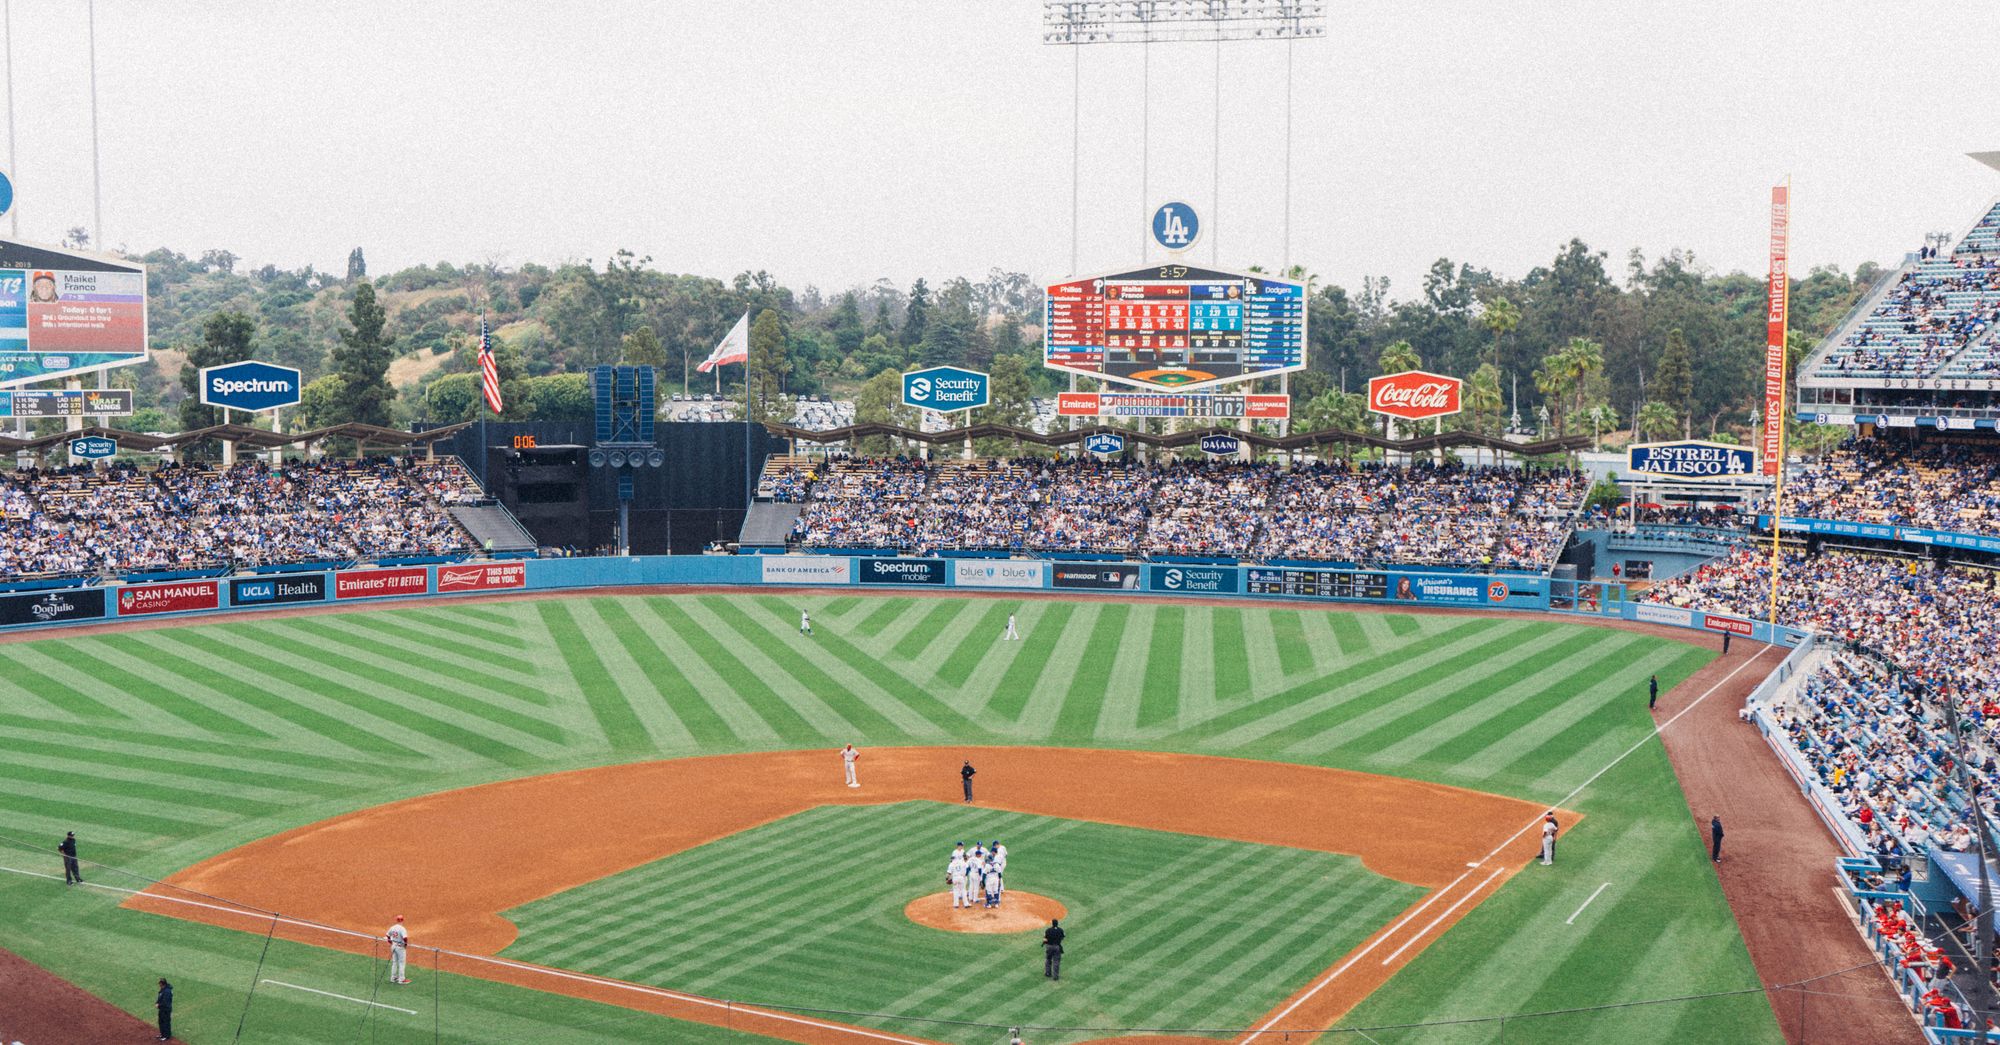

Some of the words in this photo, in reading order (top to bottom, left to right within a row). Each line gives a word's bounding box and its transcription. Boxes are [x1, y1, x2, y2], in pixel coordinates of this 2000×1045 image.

[1163, 207, 1188, 243] LA
[1773, 241, 1786, 257] FLY
[1160, 267, 1188, 278] 2:57
[64, 275, 97, 284] Maikel
[64, 283, 96, 292] Franco
[1060, 286, 1082, 294] Phillies
[1770, 257, 1784, 323] Emirates
[62, 306, 87, 314] Today:
[1767, 344, 1782, 377] BETTER
[212, 377, 289, 397] Spectrum
[935, 377, 980, 391] Security
[1767, 377, 1781, 396] FLY
[935, 390, 975, 402] Benefit
[91, 398, 122, 406] DRAFT
[1062, 400, 1097, 410] Emirates
[1216, 403, 1222, 416] 0
[1226, 403, 1233, 416] 0
[1236, 403, 1243, 416] 2
[1764, 396, 1779, 464] Emirates
[514, 436, 536, 448] 0:06
[1088, 437, 1101, 450] JIM
[1102, 435, 1121, 450] BEAM
[1203, 440, 1237, 450] DASANI
[1638, 460, 1722, 474] JALISCO
[1741, 516, 1755, 524] 2:57
[486, 567, 502, 576] THIS
[503, 566, 524, 575] BUD'S
[873, 561, 928, 575] Spectrum
[960, 567, 984, 577] blue
[1002, 568, 1026, 578] blue
[486, 576, 500, 584] FOR
[502, 575, 518, 584] YOU.
[901, 573, 928, 582] mobile
[1186, 570, 1224, 582] Security
[339, 578, 385, 591] Emirates
[387, 576, 400, 588] FLY
[400, 576, 424, 586] BETTER
[1186, 580, 1218, 590] Benefit
[1417, 578, 1452, 588] Adriana's
[136, 589, 162, 601] SAN
[164, 586, 214, 598] MANUEL
[242, 586, 272, 598] UCLA
[278, 582, 318, 596] Health
[1423, 586, 1478, 597] INSURANCE
[1490, 587, 1504, 597] 76
[136, 600, 171, 609] CASINO
[1707, 618, 1732, 629] Emirates
